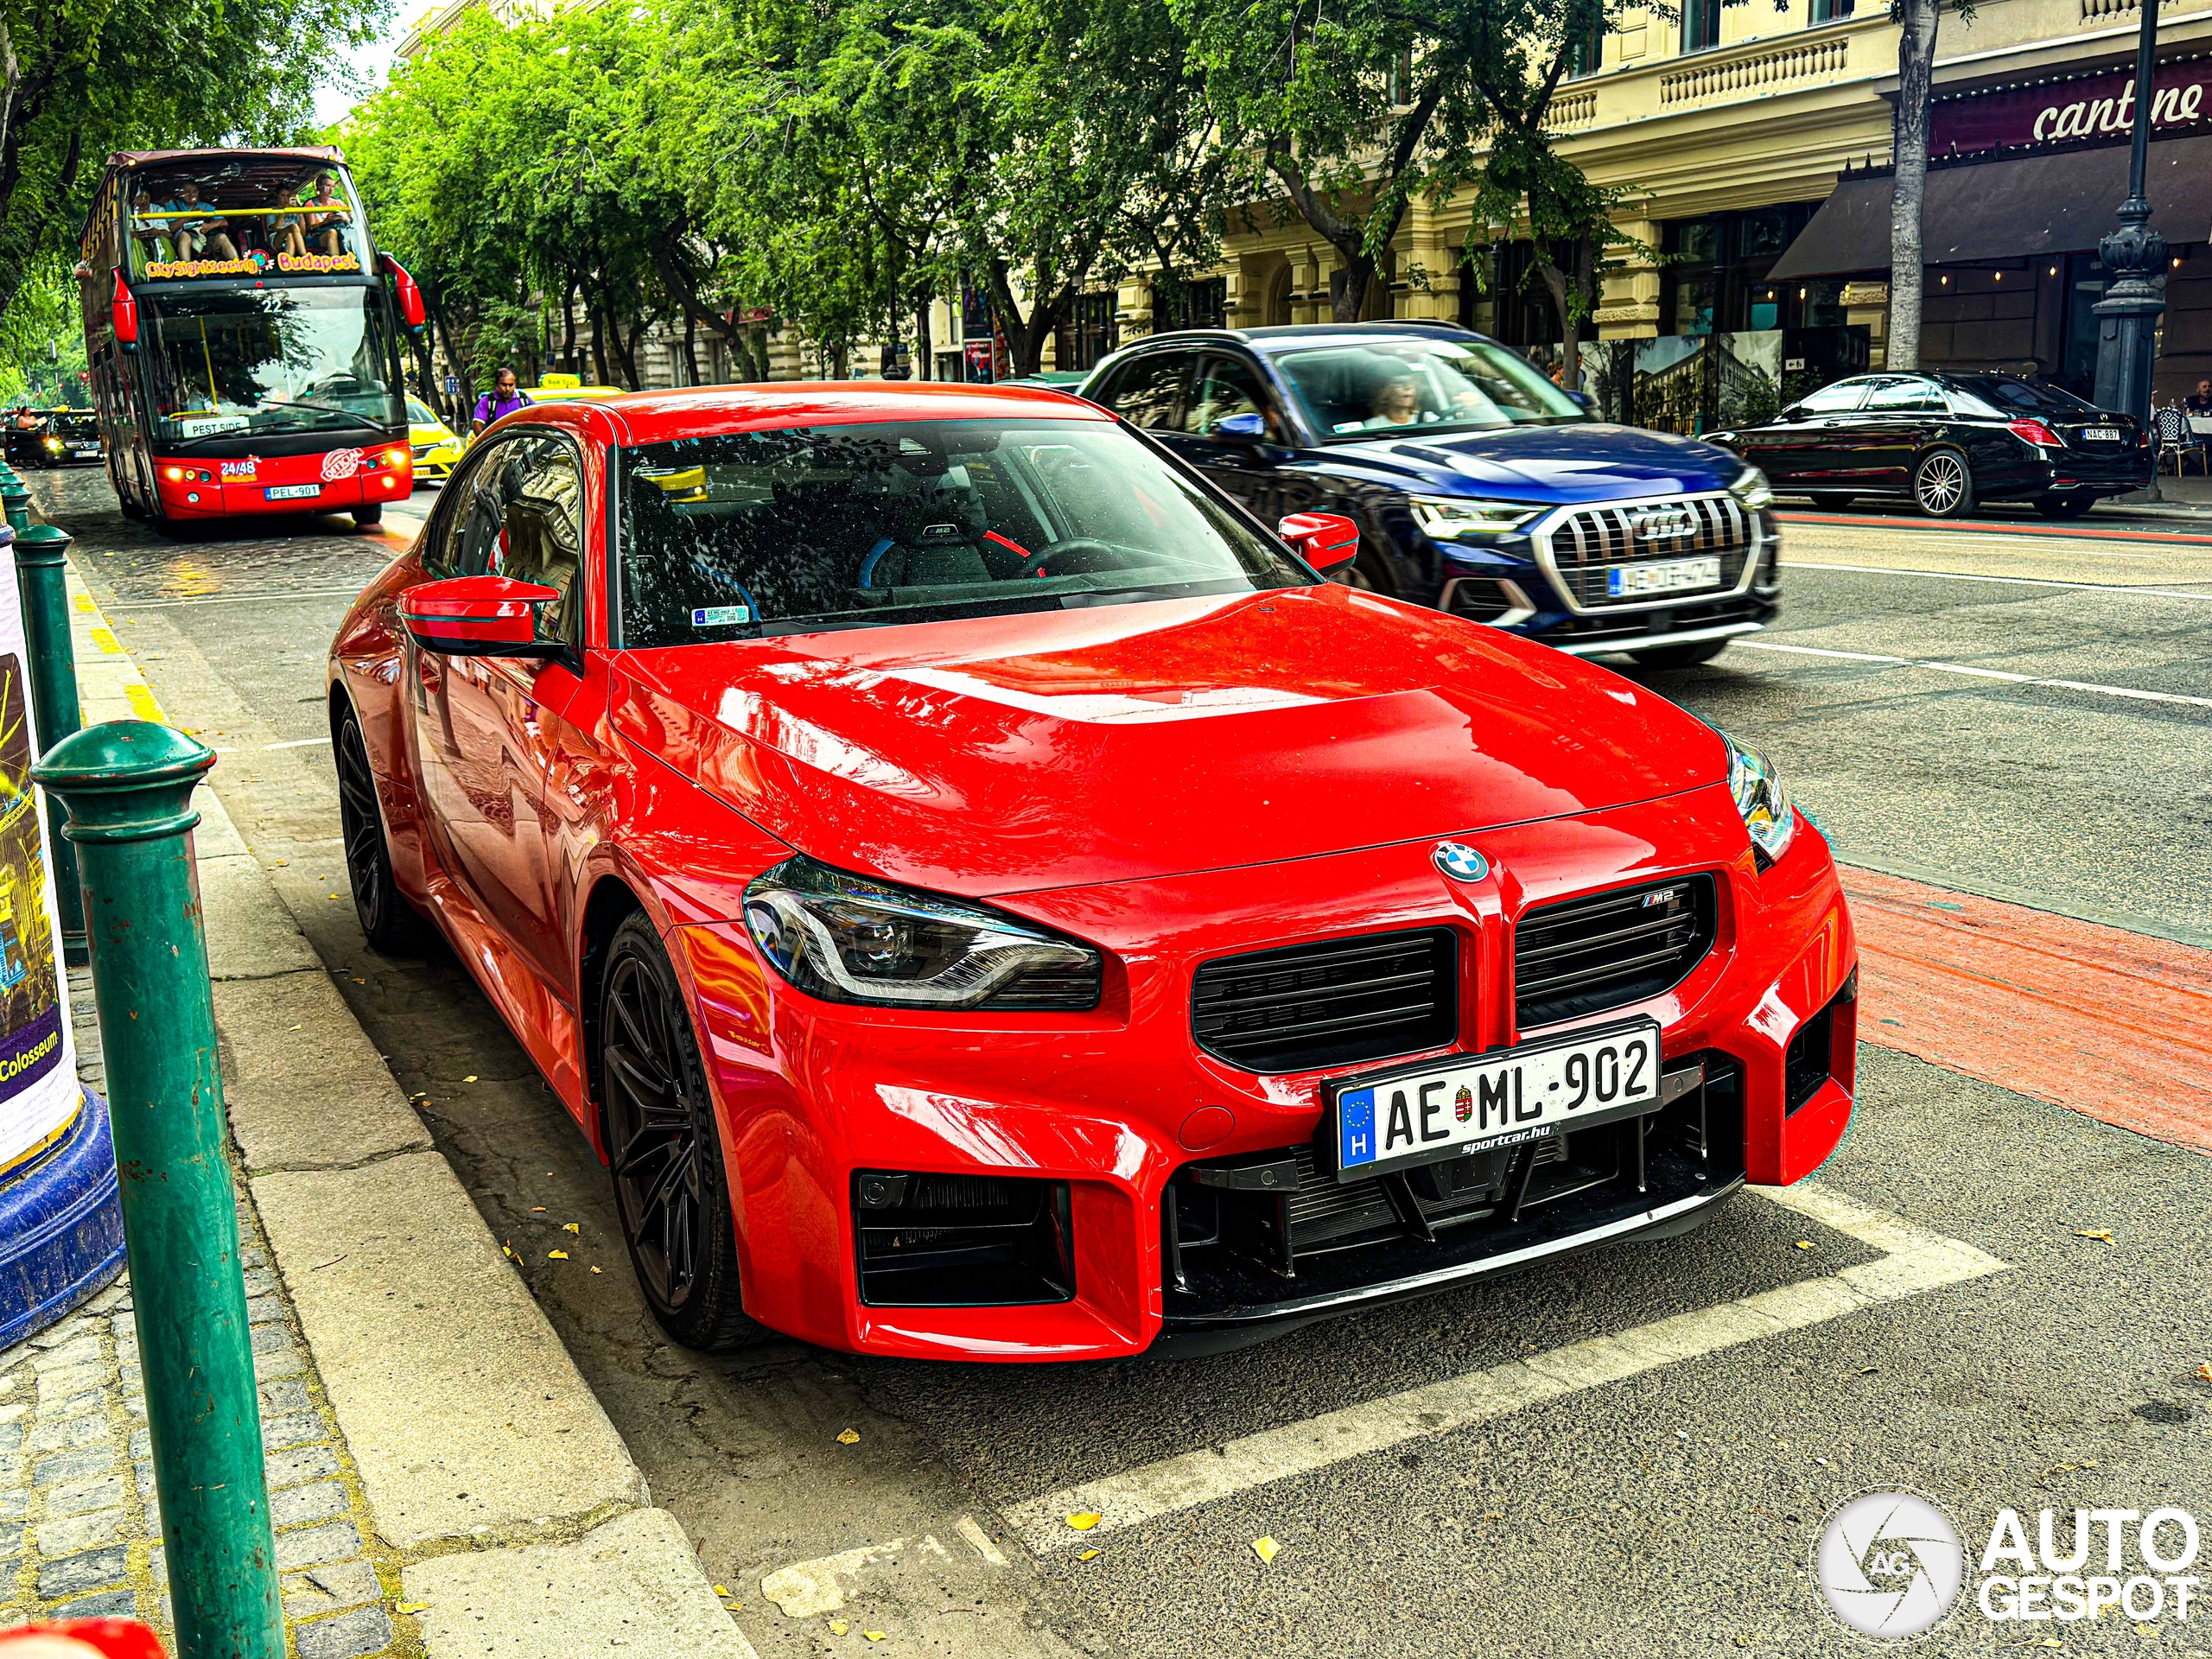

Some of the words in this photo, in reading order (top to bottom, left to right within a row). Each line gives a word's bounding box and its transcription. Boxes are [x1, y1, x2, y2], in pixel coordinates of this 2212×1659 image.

[2033, 79, 2203, 141] cantne
[145, 257, 258, 278] CitySightseeing
[277, 251, 360, 273] Budapest
[261, 299, 283, 313] 22
[192, 423, 217, 435] PEST
[2087, 429, 2118, 439] NAC-887
[219, 461, 256, 475] 24/48
[322, 448, 363, 480] OFFICIAL
[272, 486, 317, 498] PEL-901
[0, 1030, 59, 1082] Colosseum
[679, 1033, 715, 1188] MICHELIN
[1385, 1080, 1451, 1151] AE
[1351, 1133, 1368, 1157] H
[1461, 1124, 1552, 1155] sportcar.hu
